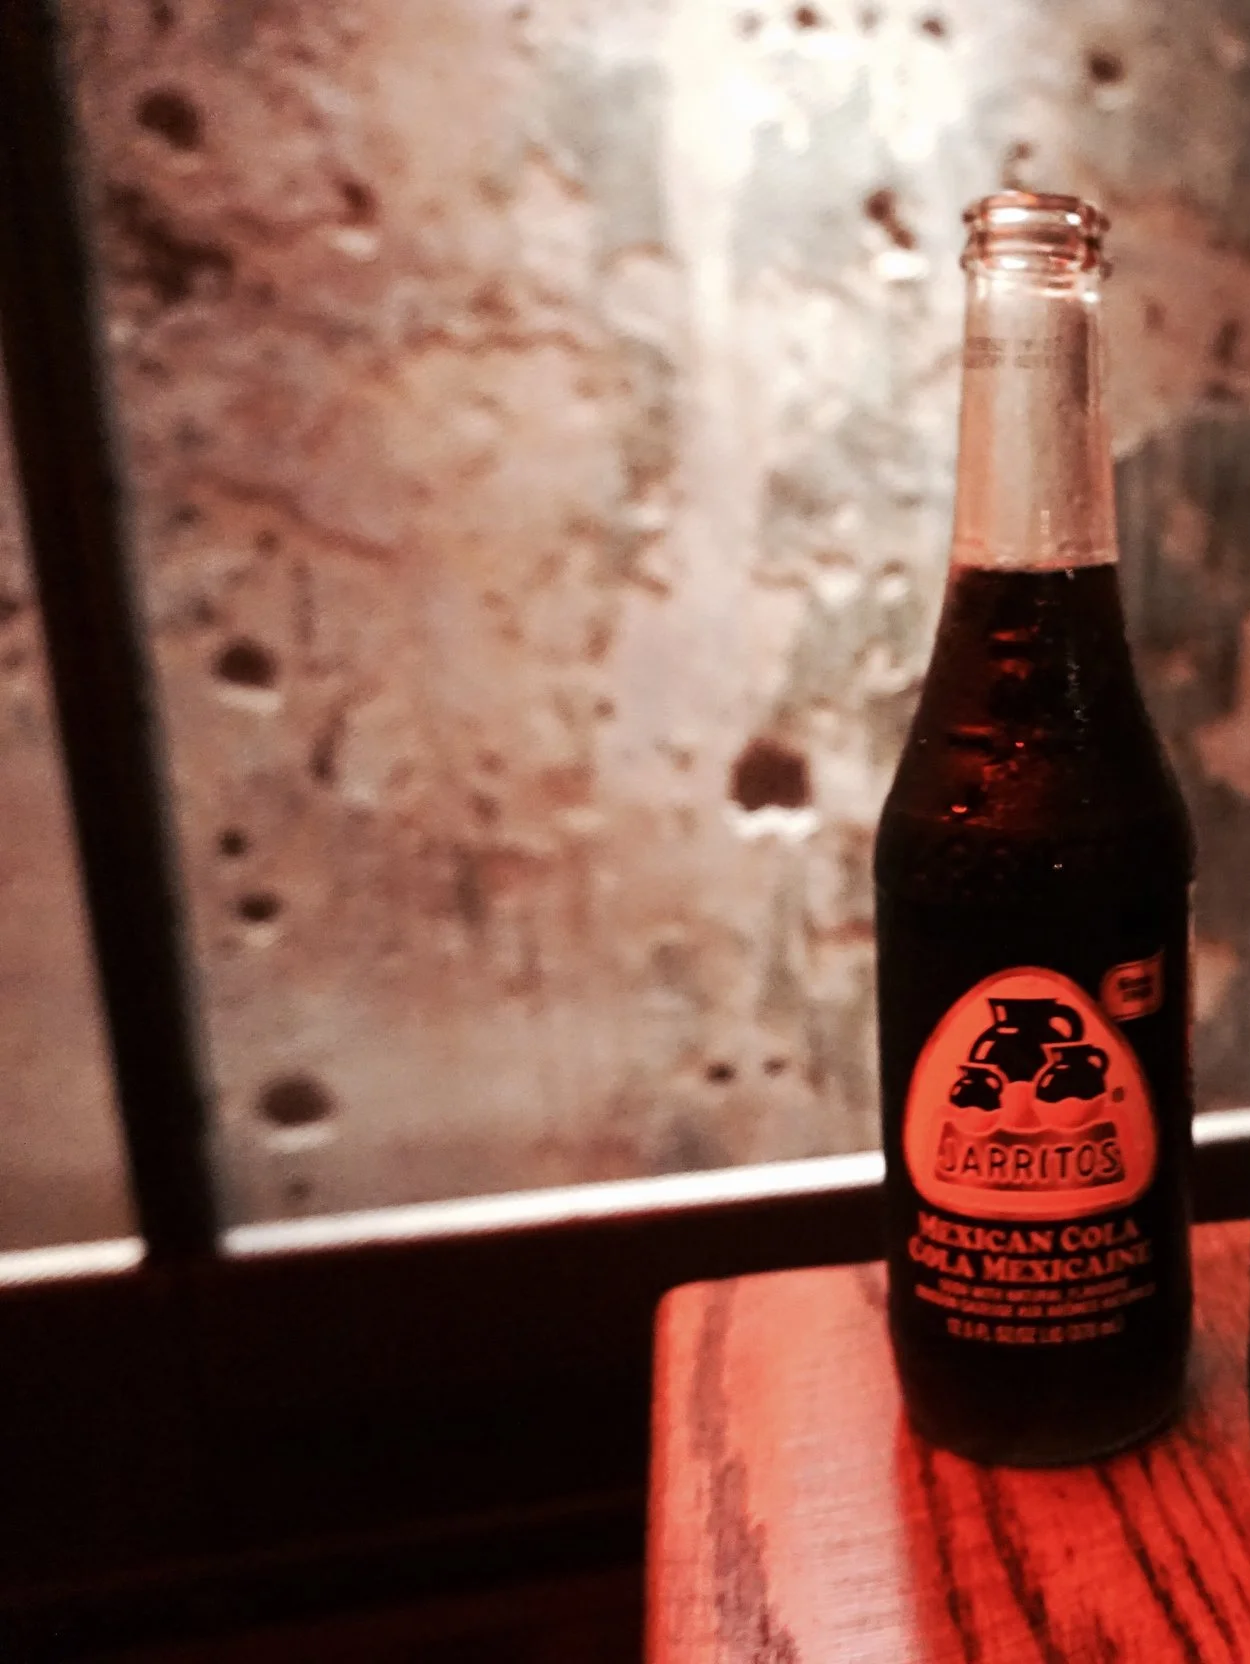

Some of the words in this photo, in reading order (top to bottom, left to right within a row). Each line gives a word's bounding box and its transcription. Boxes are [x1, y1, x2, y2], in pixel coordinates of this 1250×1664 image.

[941, 1137, 1121, 1180] JARRITOS
[919, 1211, 1054, 1253] MEXICAN
[1060, 1218, 1139, 1250] COLA
[908, 1236, 975, 1278] COLA
[982, 1240, 1153, 1283] MEXICAINE
